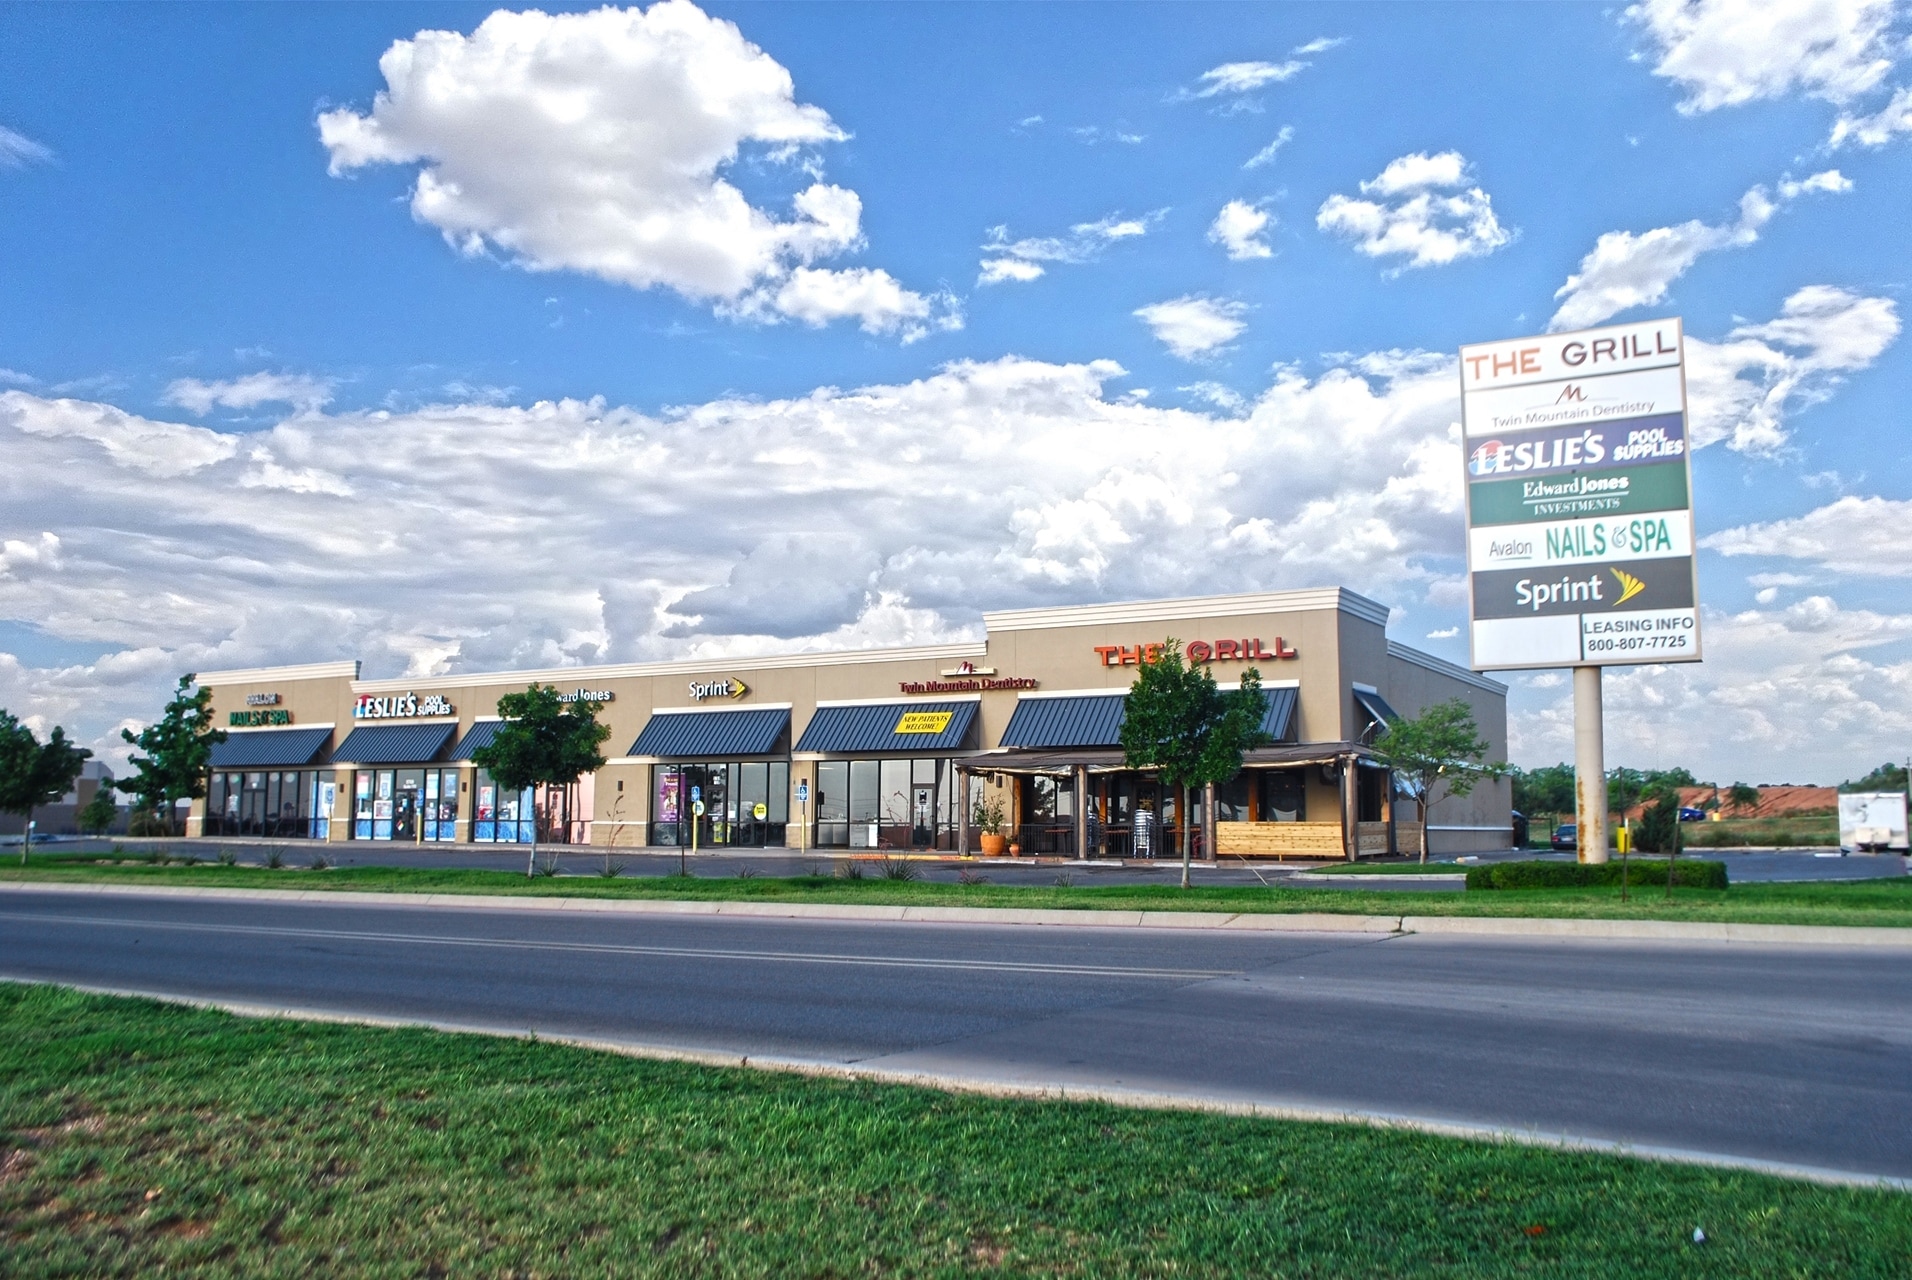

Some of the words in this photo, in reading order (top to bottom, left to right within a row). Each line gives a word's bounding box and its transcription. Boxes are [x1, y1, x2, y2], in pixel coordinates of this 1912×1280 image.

[1466, 347, 1542, 380] THE
[1561, 331, 1677, 366] GRILL
[1492, 416, 1522, 428] Twin
[1525, 405, 1589, 424] Mountain
[1593, 400, 1655, 417] Dentistry
[1628, 427, 1669, 445] POOL
[1475, 430, 1606, 476] LESLIE'S
[1612, 439, 1684, 461] SUPPLIES
[1534, 497, 1620, 516] INVESTMENTS
[1489, 539, 1532, 558] Avalon
[1546, 522, 1607, 560] NAILS
[1630, 518, 1672, 554] SPA
[1515, 574, 1604, 611] Sprint
[1584, 619, 1653, 634] LEASING
[1656, 616, 1694, 631] INFO
[1094, 643, 1165, 666] THE
[1186, 637, 1296, 663] GRILL
[1588, 635, 1687, 652] 800-807-7725
[689, 680, 729, 701] Sprint
[899, 681, 925, 693] Twin
[925, 679, 980, 692] Mountain
[981, 677, 1037, 690] Dentistry
[355, 691, 417, 718] LESLIE'S
[417, 703, 452, 716] SUPPLIES
[424, 695, 445, 706] POOL
[229, 710, 260, 727] NAILS
[270, 709, 289, 725] SPA
[904, 715, 918, 723] NEW
[918, 715, 949, 723] PATIENTS
[905, 722, 940, 730] WELCOME!
